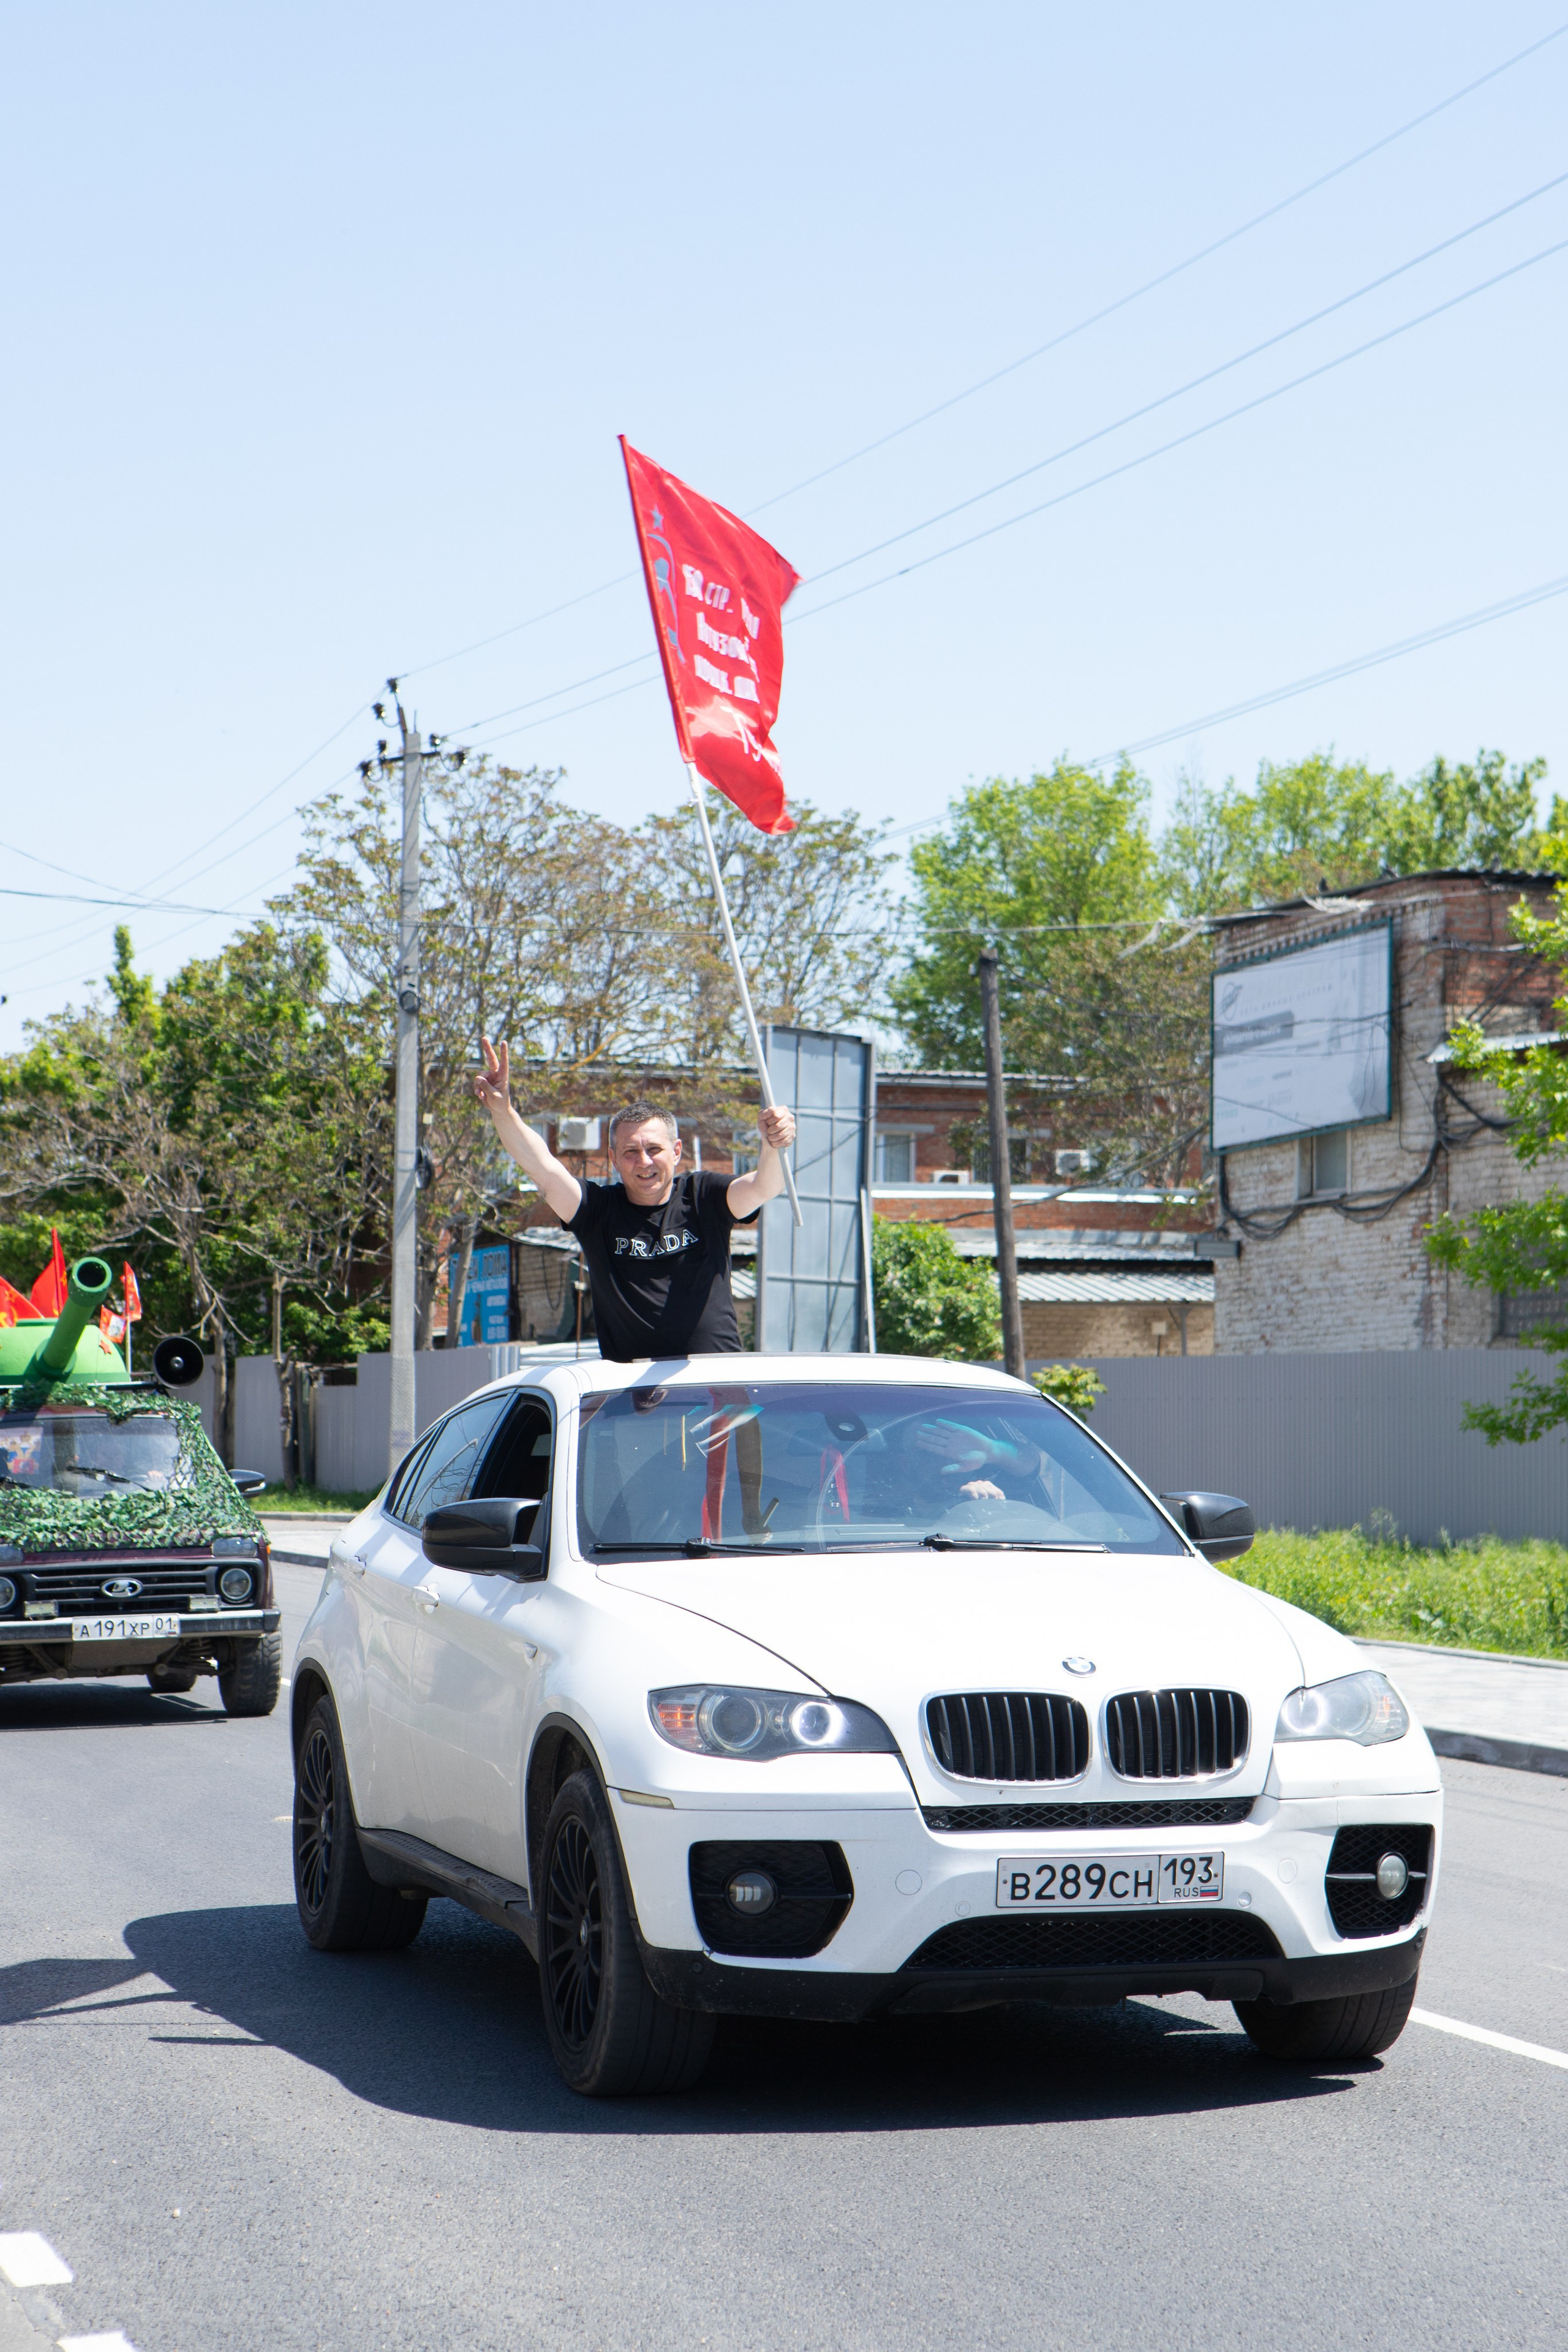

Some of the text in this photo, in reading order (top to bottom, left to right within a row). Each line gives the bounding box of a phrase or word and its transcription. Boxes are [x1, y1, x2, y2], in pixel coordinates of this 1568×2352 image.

[614, 1229, 698, 1257] PRADA
[80, 1618, 172, 1637] А191ХР 01
[1010, 1856, 1213, 1901] В289СН 193
[1174, 1887, 1199, 1898] RUS
